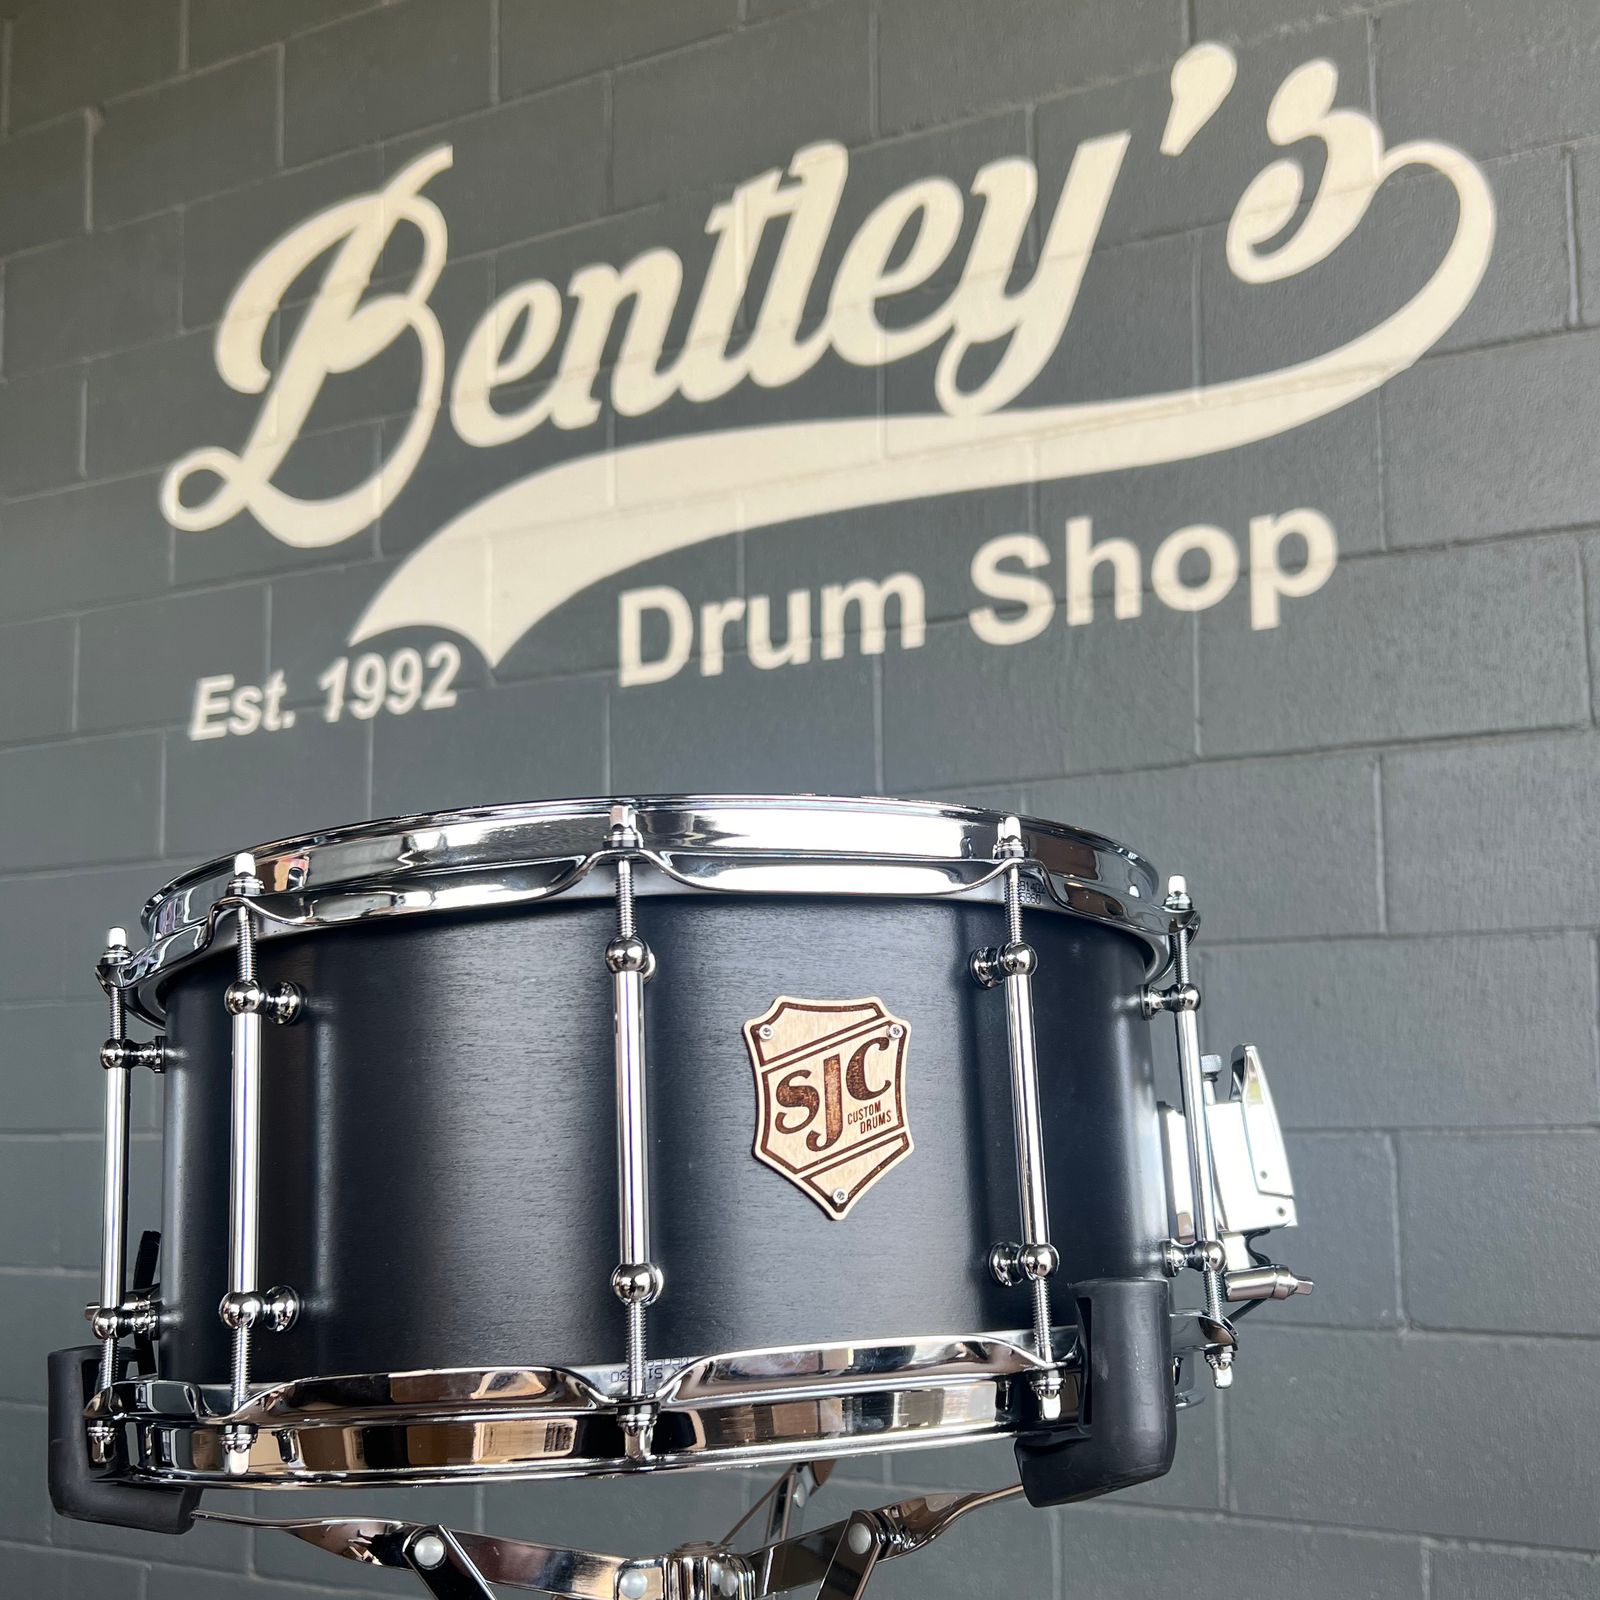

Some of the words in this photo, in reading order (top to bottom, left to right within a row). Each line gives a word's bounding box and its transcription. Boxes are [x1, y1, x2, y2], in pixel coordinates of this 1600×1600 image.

[163, 40, 1497, 550] Bentley's
[618, 571, 926, 688] Drum
[968, 507, 1338, 646] Shop
[188, 669, 297, 742] Est.
[318, 641, 462, 724] 1992
[774, 1037, 893, 1153] SJC
[847, 1100, 882, 1126] CUSTOM
[860, 1110, 892, 1135] DRUMS
